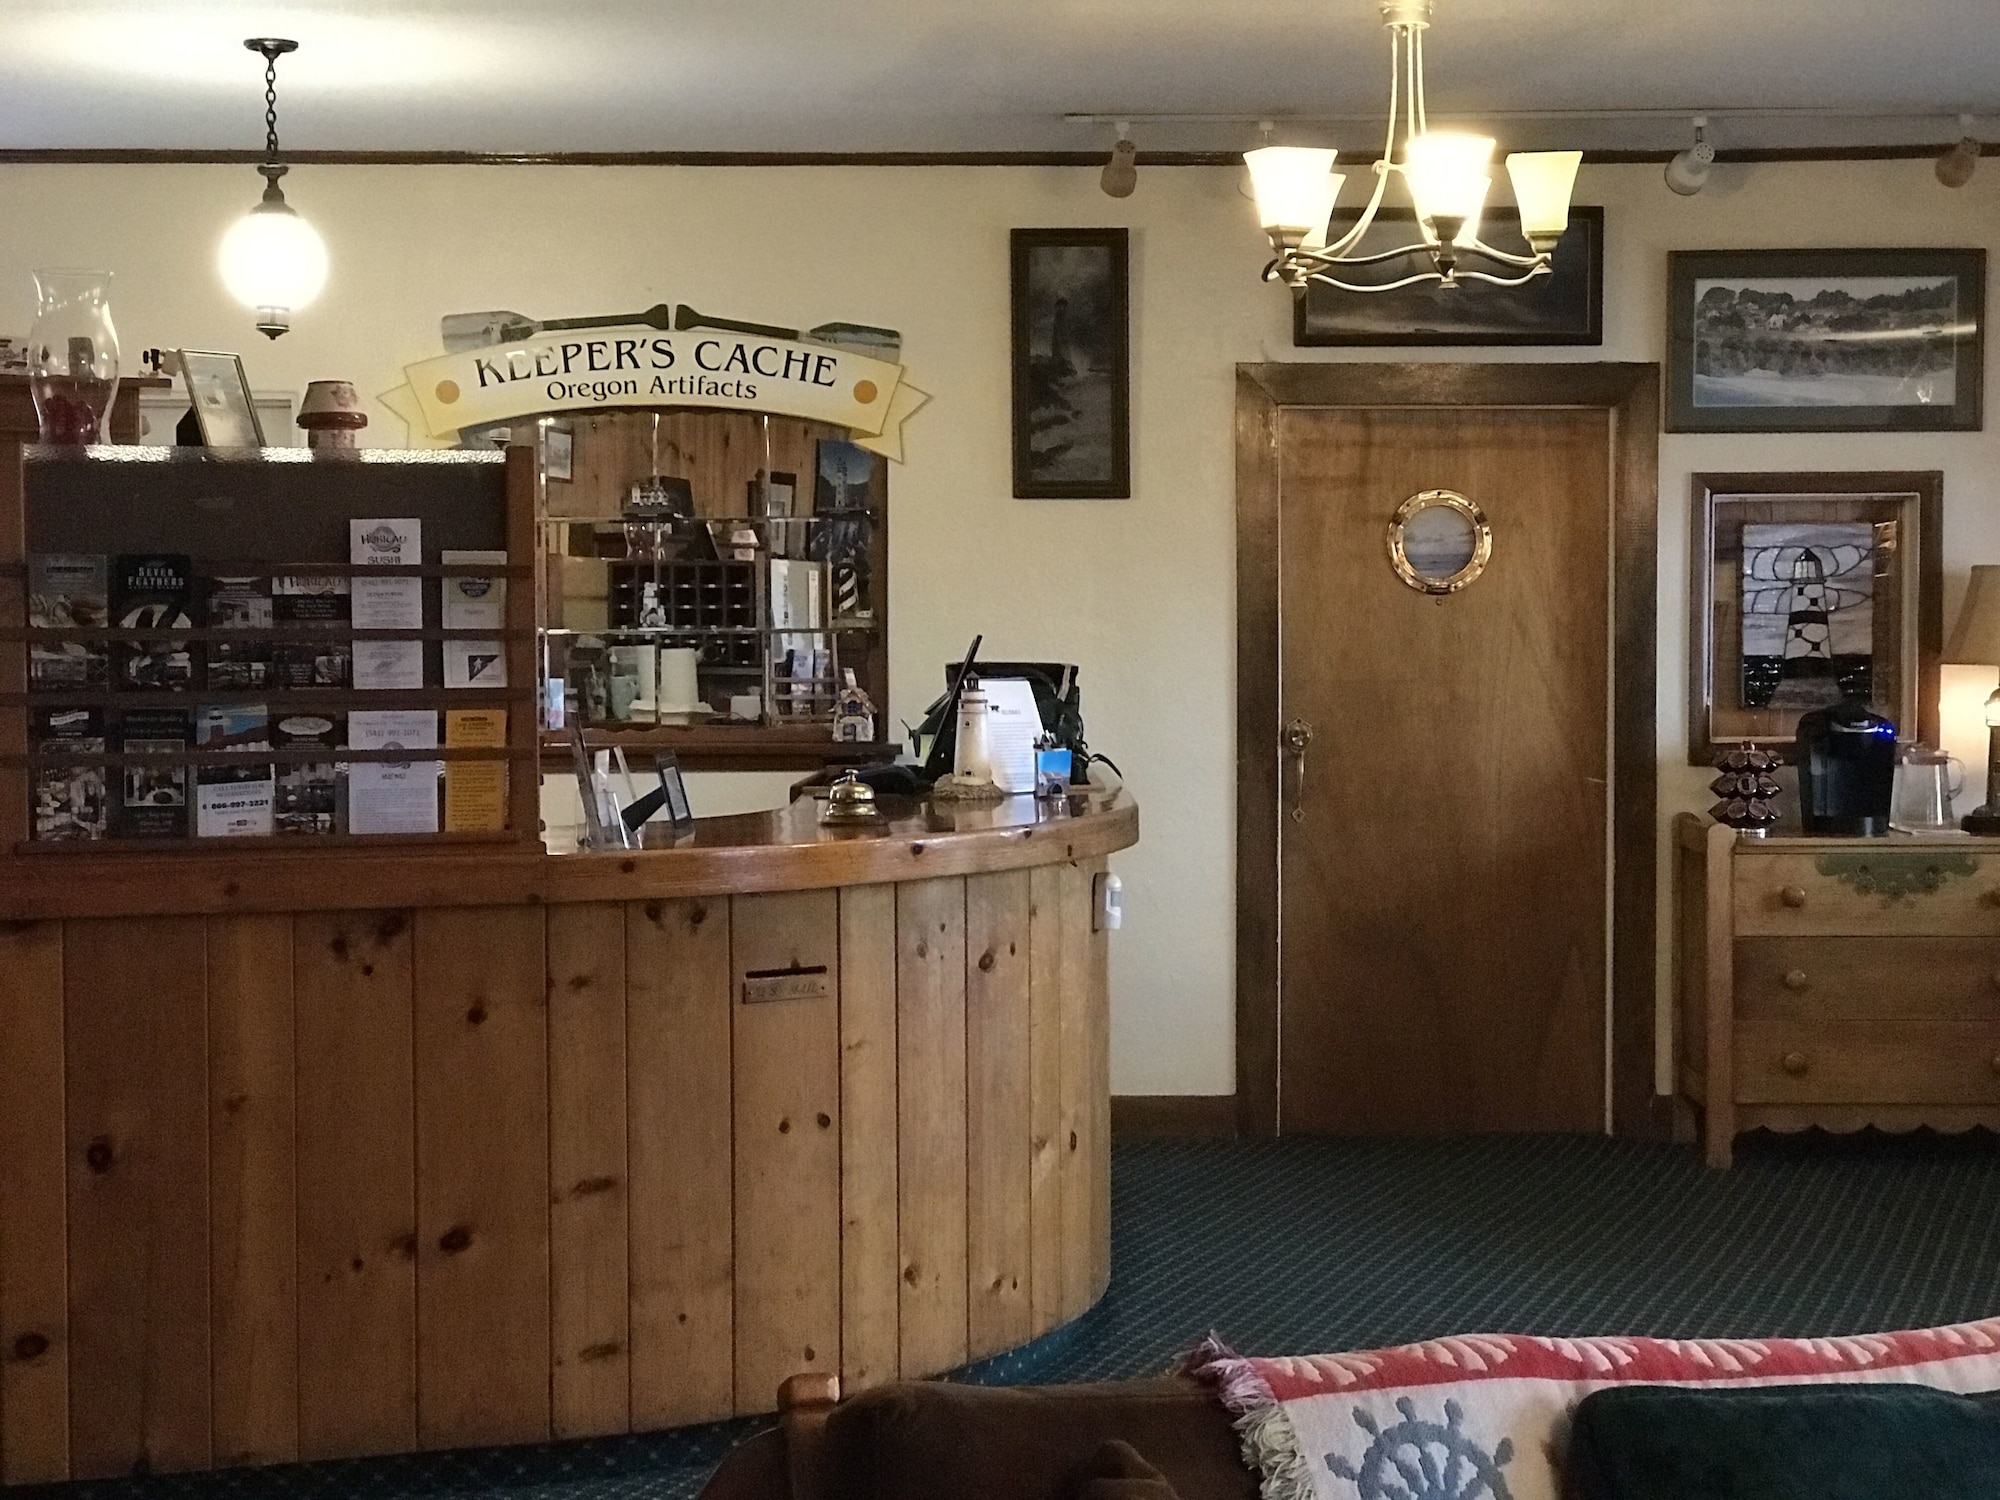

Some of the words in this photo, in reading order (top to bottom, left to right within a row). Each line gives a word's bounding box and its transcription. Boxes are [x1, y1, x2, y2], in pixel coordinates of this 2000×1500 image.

[474, 338, 675, 389] KEEPER'S
[694, 340, 838, 388] CACHE
[546, 377, 638, 402] Oregon
[649, 374, 758, 400] Artifacts
[138, 566, 174, 577] SEVEN
[128, 576, 185, 587] FEATHERS
